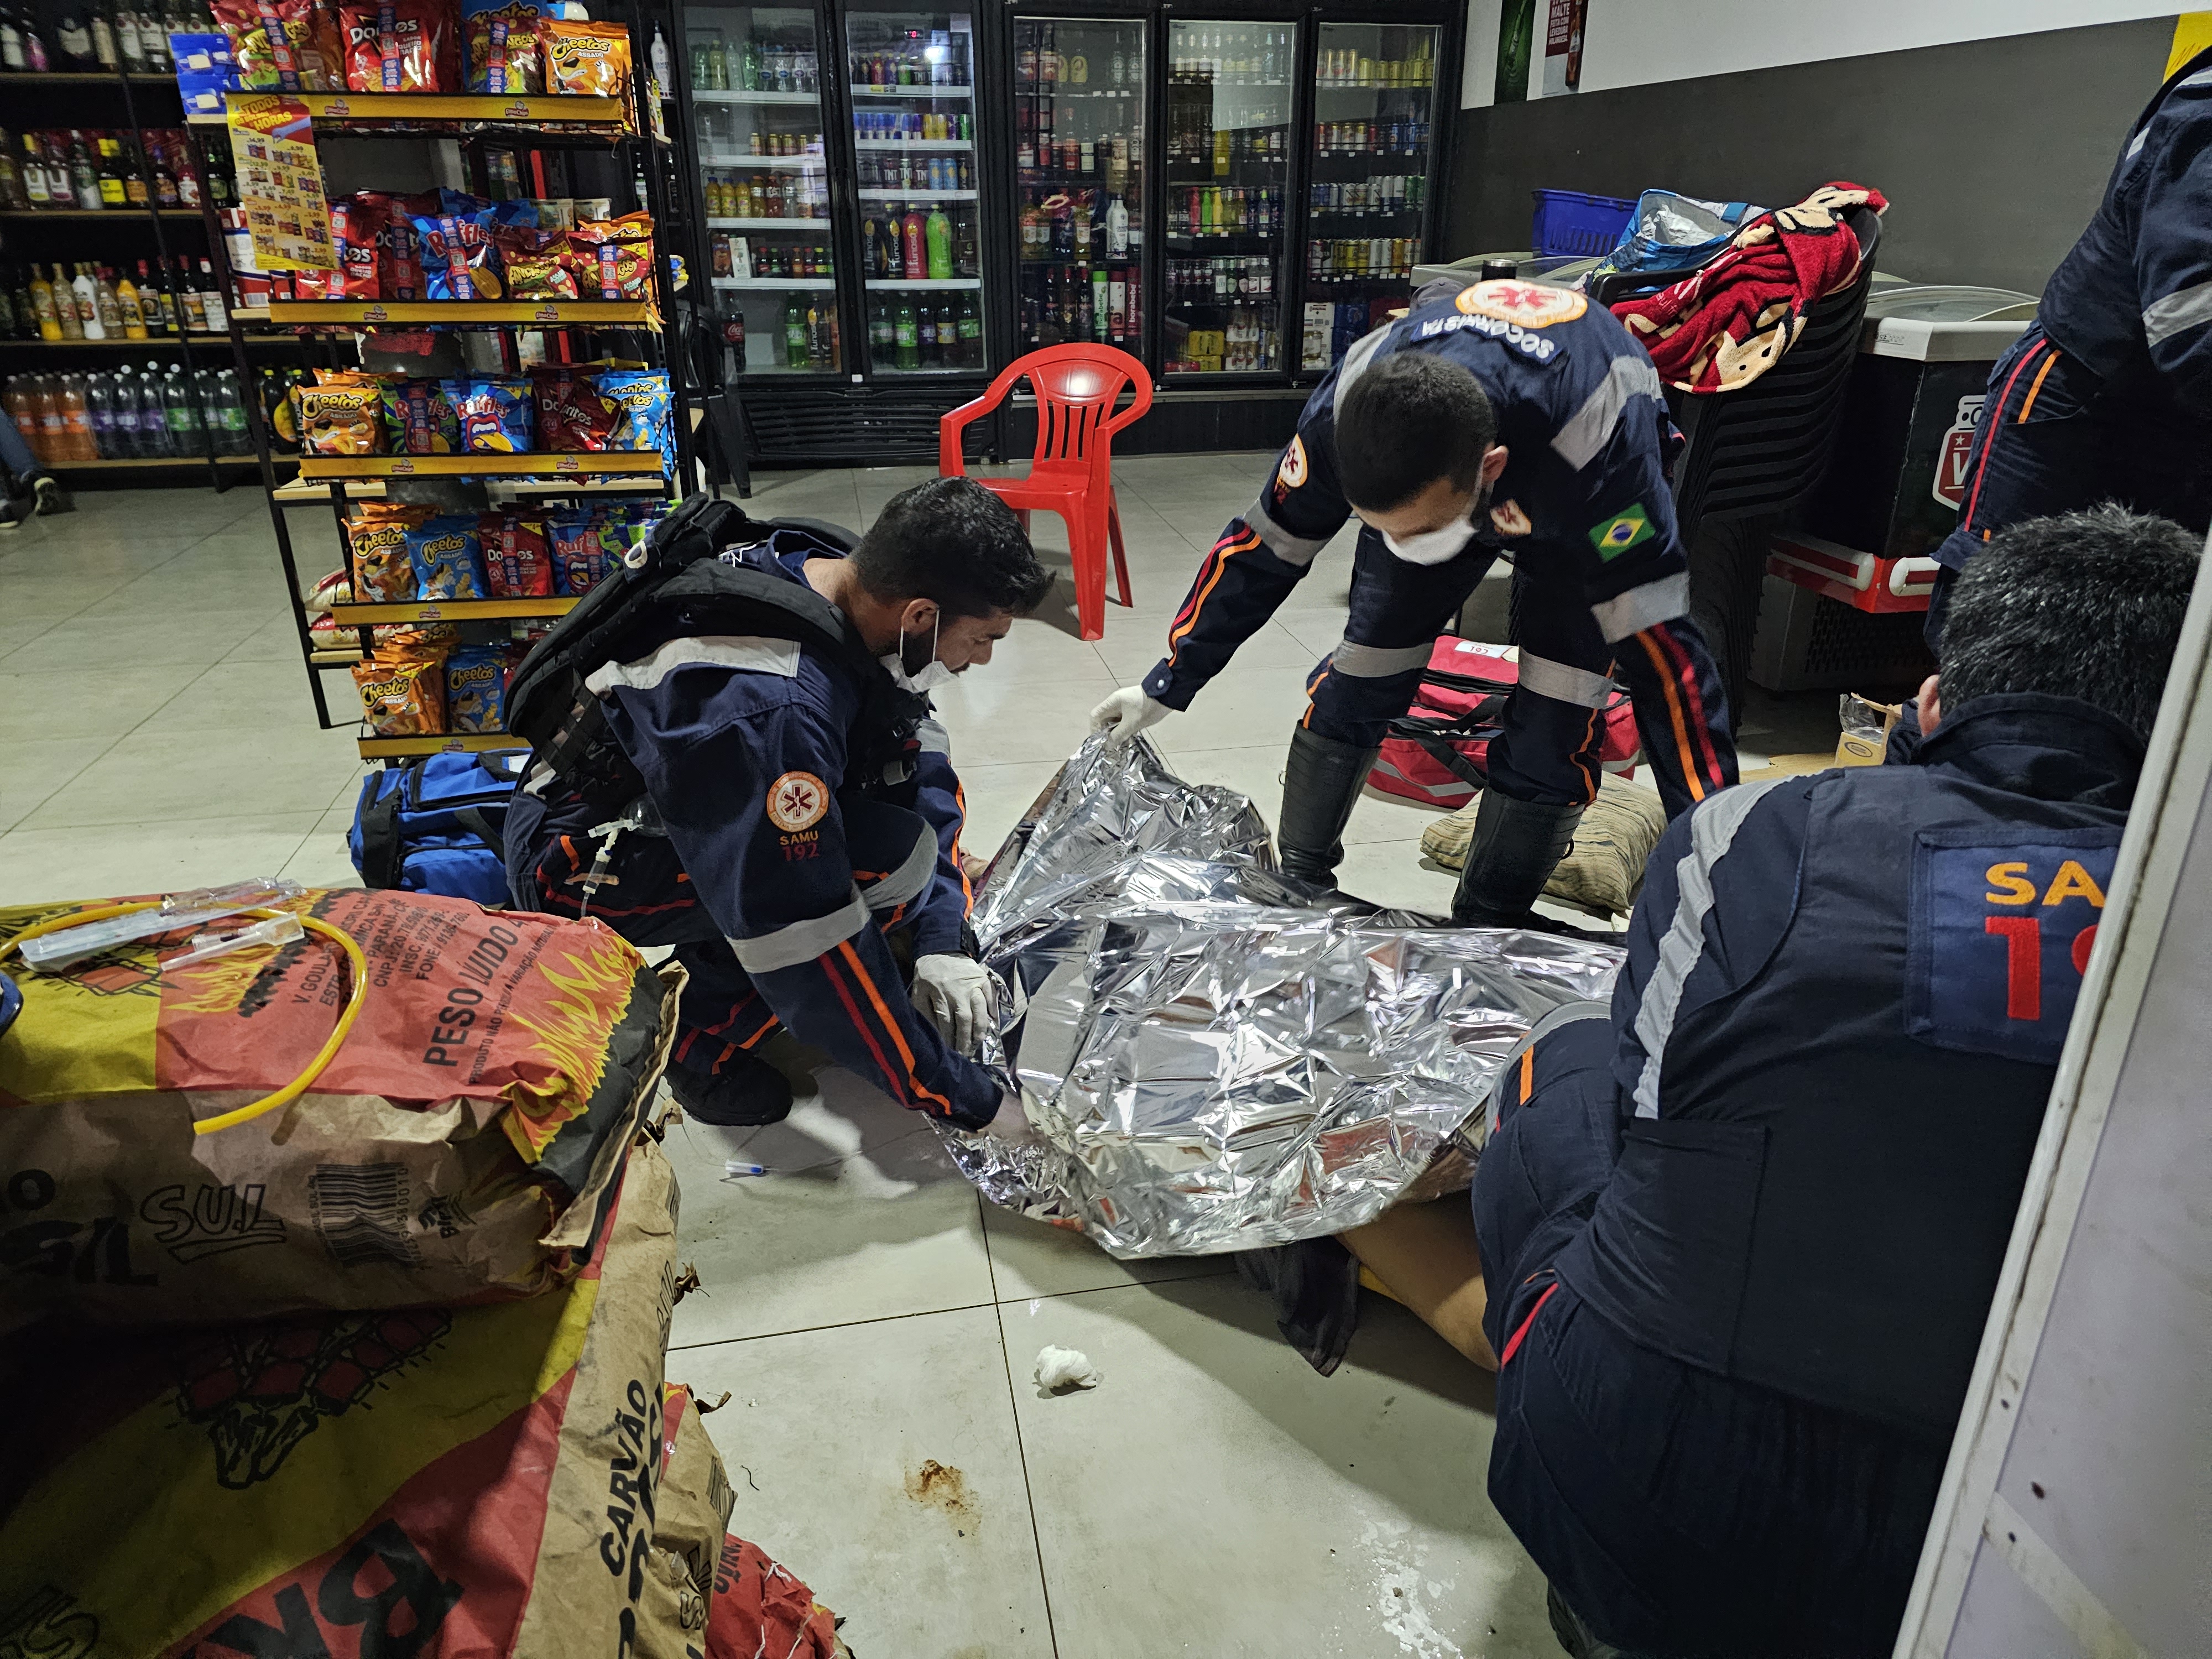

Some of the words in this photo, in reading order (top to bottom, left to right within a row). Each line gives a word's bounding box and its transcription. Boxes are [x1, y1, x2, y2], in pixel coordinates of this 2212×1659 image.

[1551, 3, 1571, 19] MALTE
[551, 37, 611, 60] Cheetos
[241, 95, 280, 114] TODOS
[253, 111, 293, 131] HORAS
[884, 169, 898, 181] TNT
[425, 219, 494, 258] Rffles
[302, 393, 363, 420] Cheetos
[422, 535, 465, 566] Cheetos
[1469, 645, 1489, 655] 192
[451, 666, 495, 691] Cheetos
[360, 679, 411, 708] Cheetos
[780, 830, 819, 846] SAMU
[782, 842, 820, 862] 192
[422, 987, 484, 1067] PESO
[469, 1038, 494, 1084] PRODUTO
[486, 1016, 503, 1037] NÃO
[509, 951, 538, 985] VARIAÇÃO
[139, 1183, 286, 1243] SUL
[600, 1379, 646, 1577] CARVÃO
